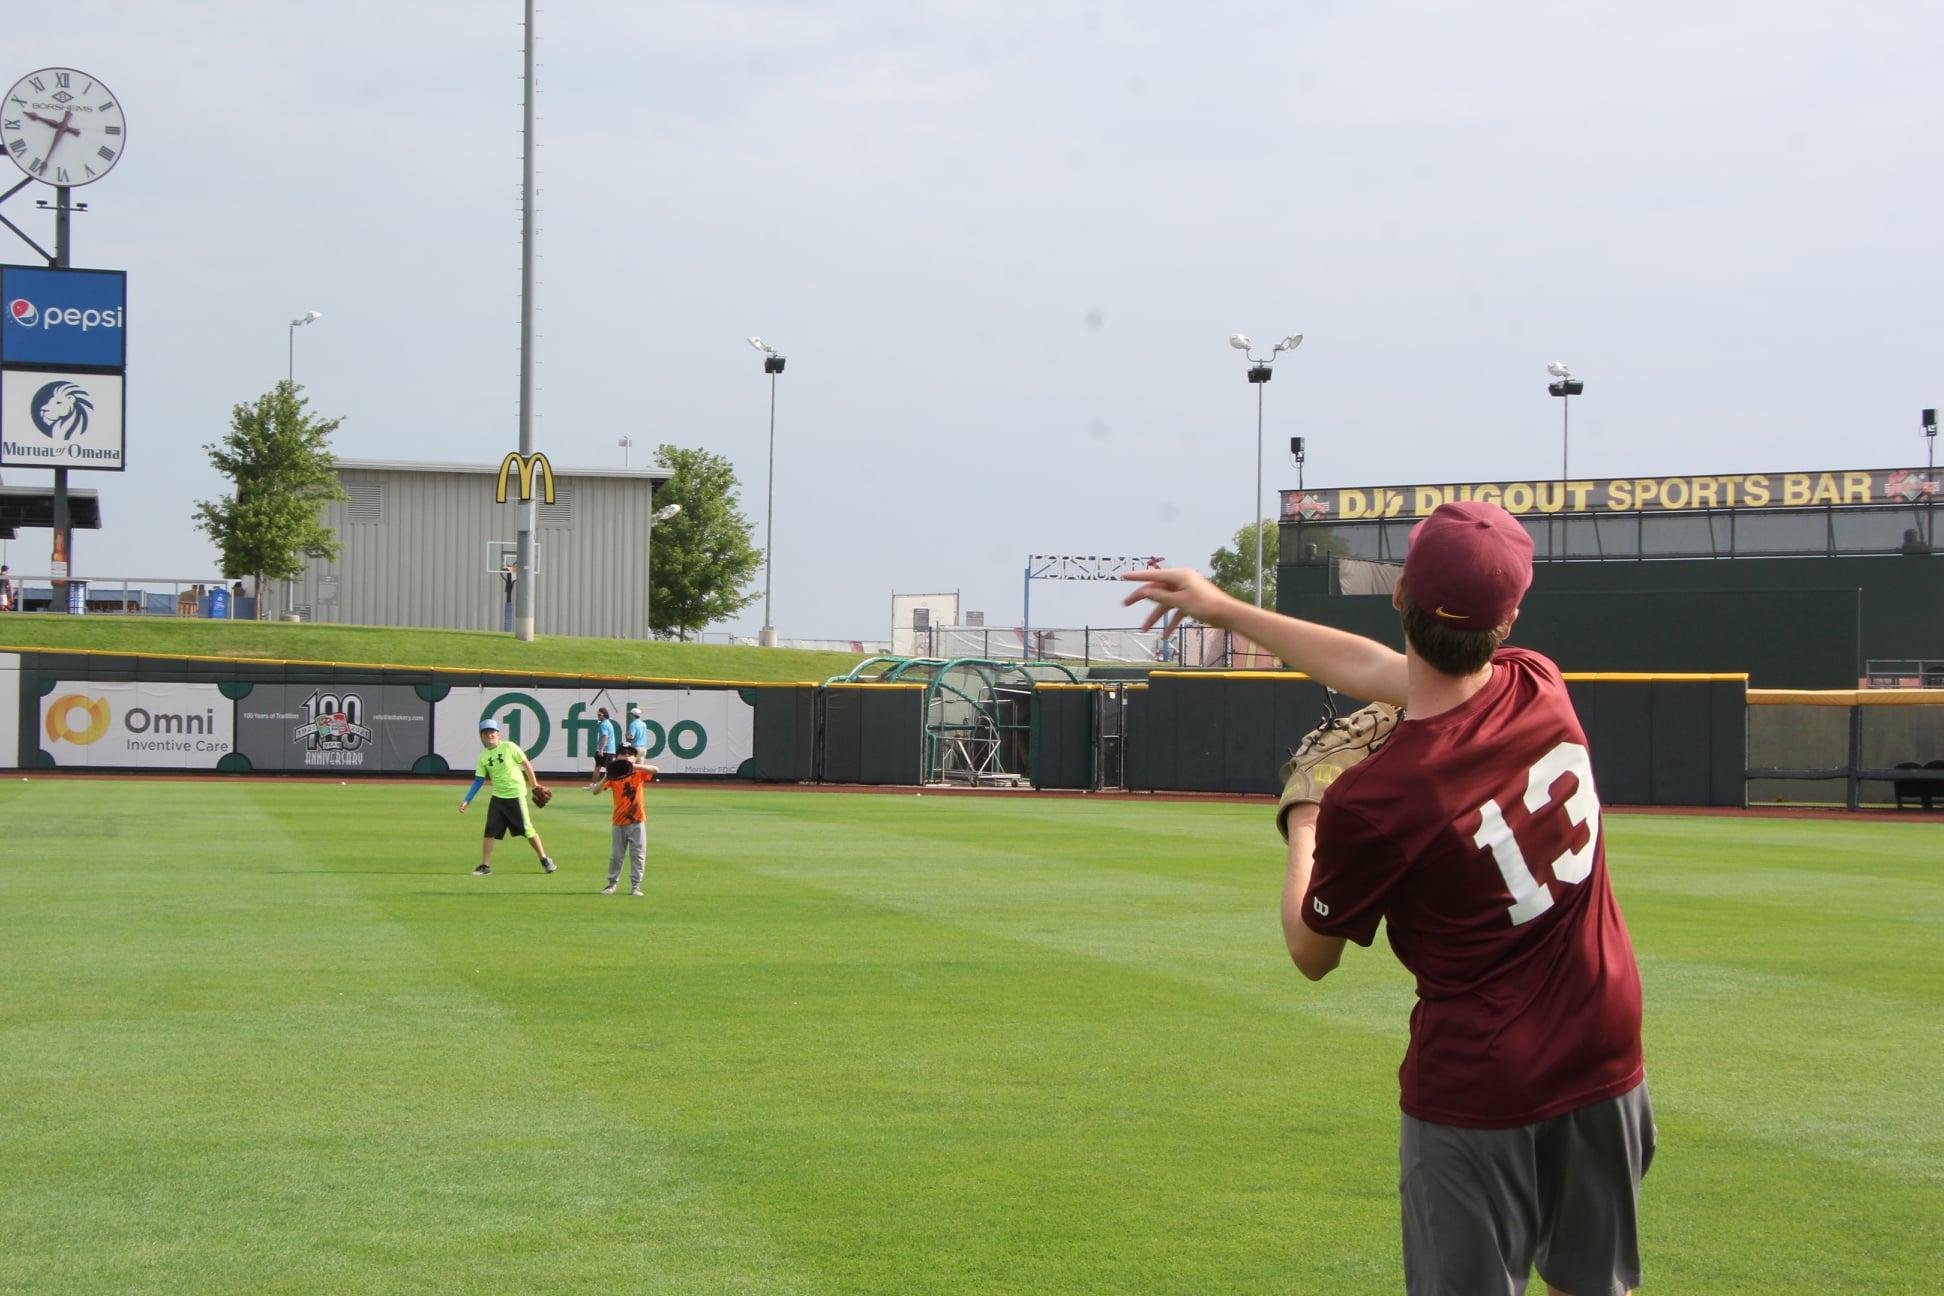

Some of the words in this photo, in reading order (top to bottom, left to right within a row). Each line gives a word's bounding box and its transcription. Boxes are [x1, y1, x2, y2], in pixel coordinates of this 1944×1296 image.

[44, 306, 123, 331] pepsi
[1414, 481, 1595, 517] DUGOUT
[1607, 474, 1770, 511] SPORTS
[1783, 472, 1873, 506] BAR
[124, 707, 214, 735] Omni
[126, 739, 192, 752] Inventive
[195, 740, 229, 752] Care
[305, 751, 363, 766] ANNIVERSARY
[685, 766, 717, 774] Member
[1473, 741, 1601, 926] 13
